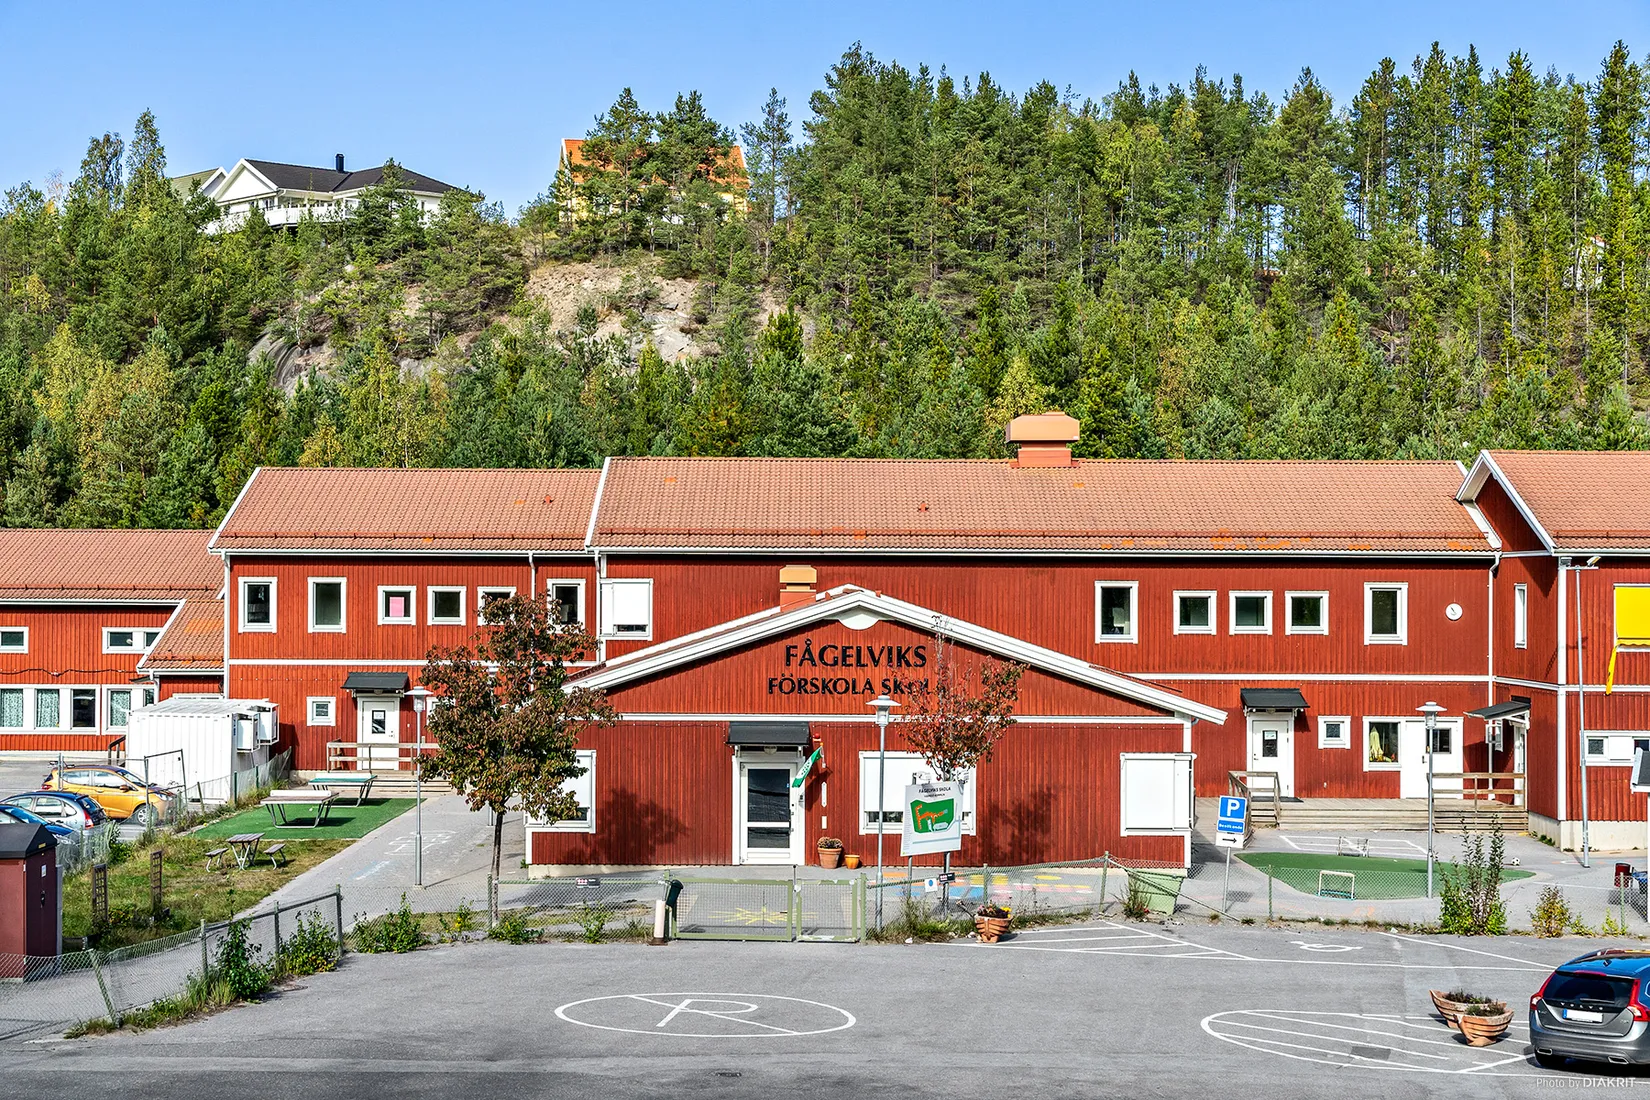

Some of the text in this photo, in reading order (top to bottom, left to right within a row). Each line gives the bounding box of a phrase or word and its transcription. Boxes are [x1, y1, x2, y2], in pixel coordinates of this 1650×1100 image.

[785, 638, 927, 668] FÅGELVIKS
[768, 673, 875, 695] FÖRSKOLA
[1227, 799, 1240, 817] P
[1560, 1002, 1603, 1010] VOLVO
